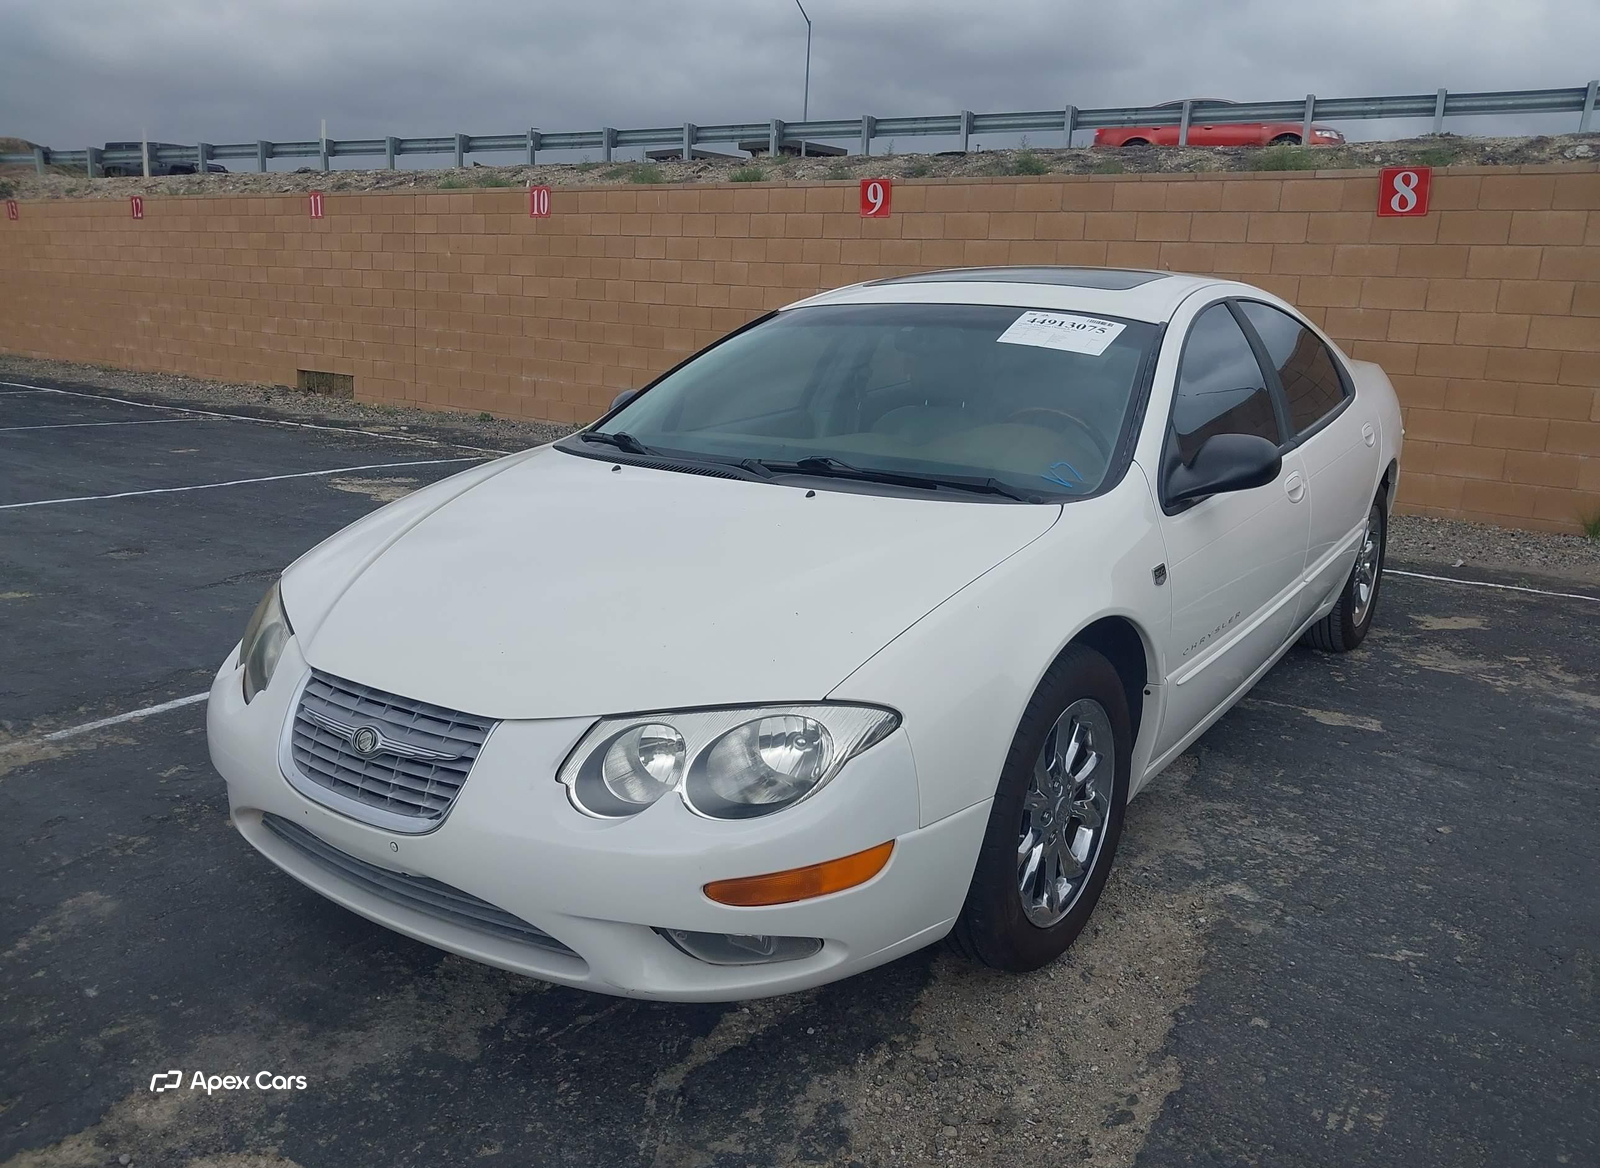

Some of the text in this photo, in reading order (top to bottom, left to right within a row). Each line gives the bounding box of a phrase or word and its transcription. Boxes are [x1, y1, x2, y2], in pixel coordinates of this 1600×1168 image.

[532, 189, 549, 215] 10
[867, 182, 884, 215] 9
[1390, 171, 1419, 212] 8
[132, 198, 142, 218] 12
[310, 195, 322, 217] 11
[1027, 317, 1107, 335] 44913075
[1182, 611, 1241, 656] CHRYSLER
